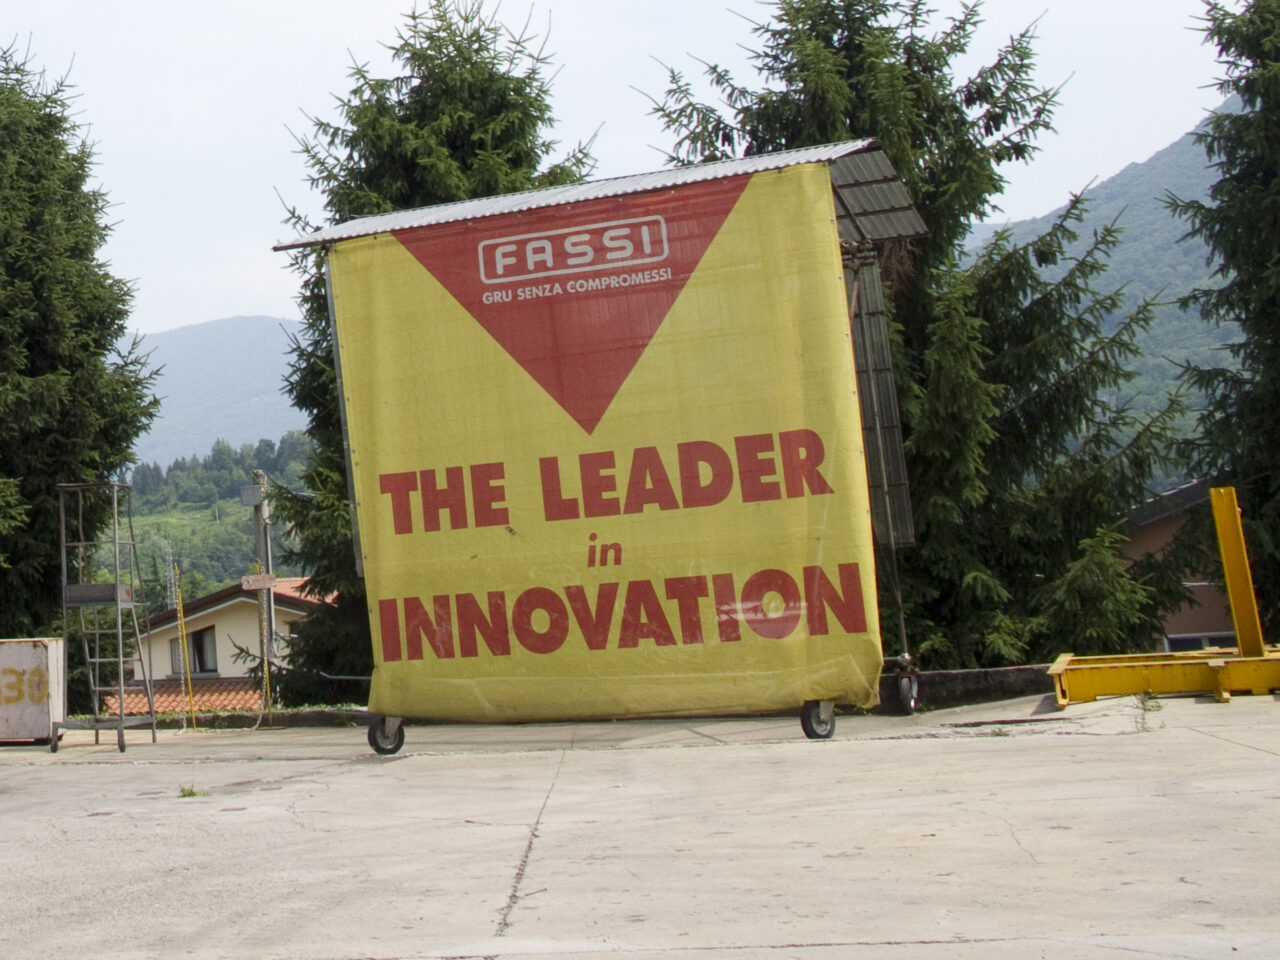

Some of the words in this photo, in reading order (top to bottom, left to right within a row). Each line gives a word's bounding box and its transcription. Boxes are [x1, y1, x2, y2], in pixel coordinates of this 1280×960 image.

[495, 225, 652, 275] FASSI
[482, 290, 512, 304] GRU
[517, 283, 563, 300] SENZA
[567, 267, 671, 294] COMPROMESSI
[379, 462, 510, 535] THE
[539, 428, 835, 522] LEADER
[587, 532, 623, 568] in
[378, 562, 868, 663] INNOVATION
